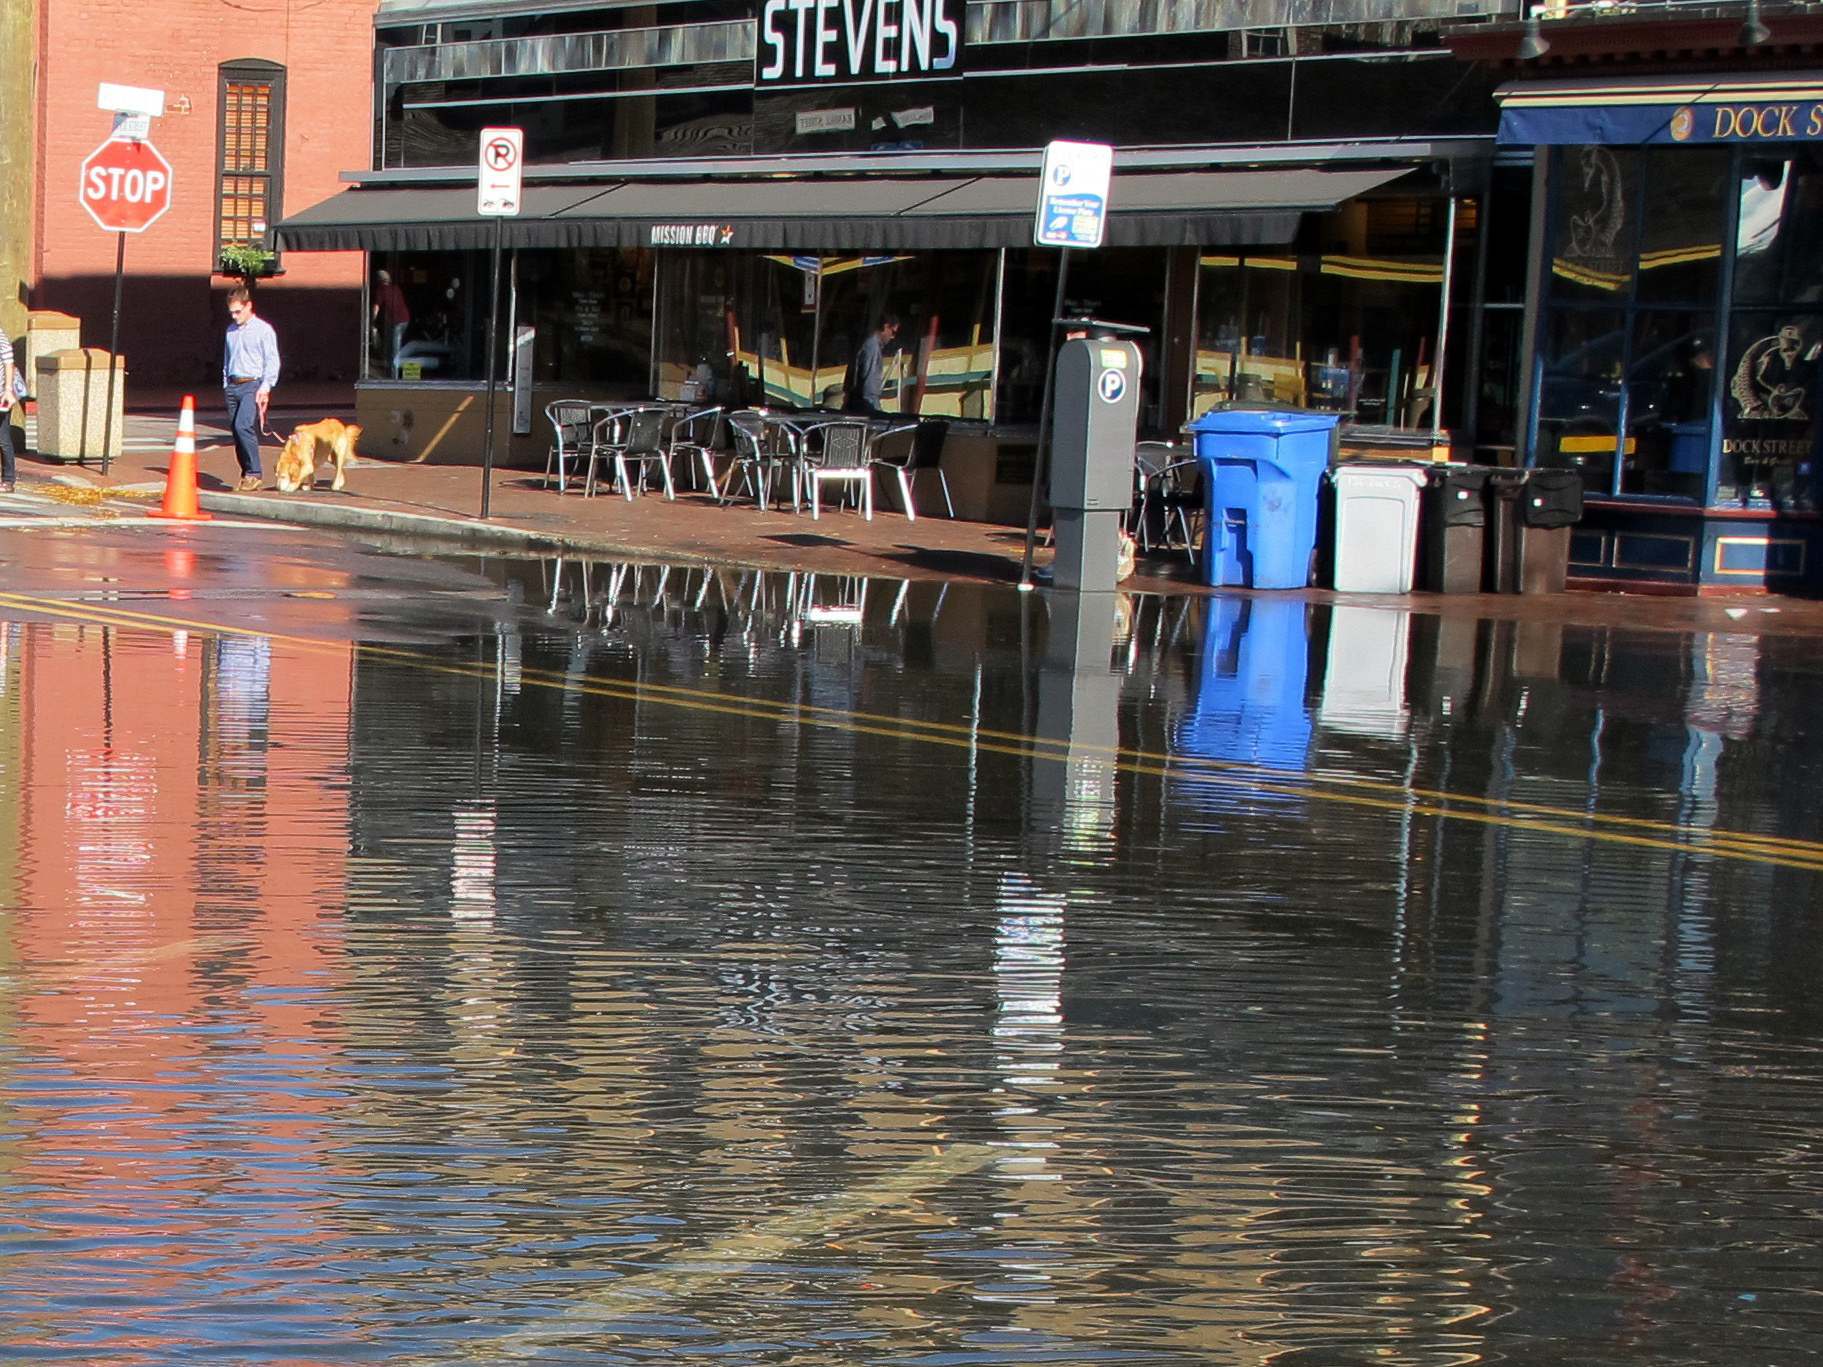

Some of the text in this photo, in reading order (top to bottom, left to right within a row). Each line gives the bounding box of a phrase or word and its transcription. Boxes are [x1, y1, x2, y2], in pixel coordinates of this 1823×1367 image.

[762, 0, 958, 79] STEVENS
[1712, 105, 1798, 138] DOCK
[86, 166, 166, 203] STOP
[651, 225, 717, 246] MISSION BBQ
[1722, 439, 1813, 454] DOCK STREET
